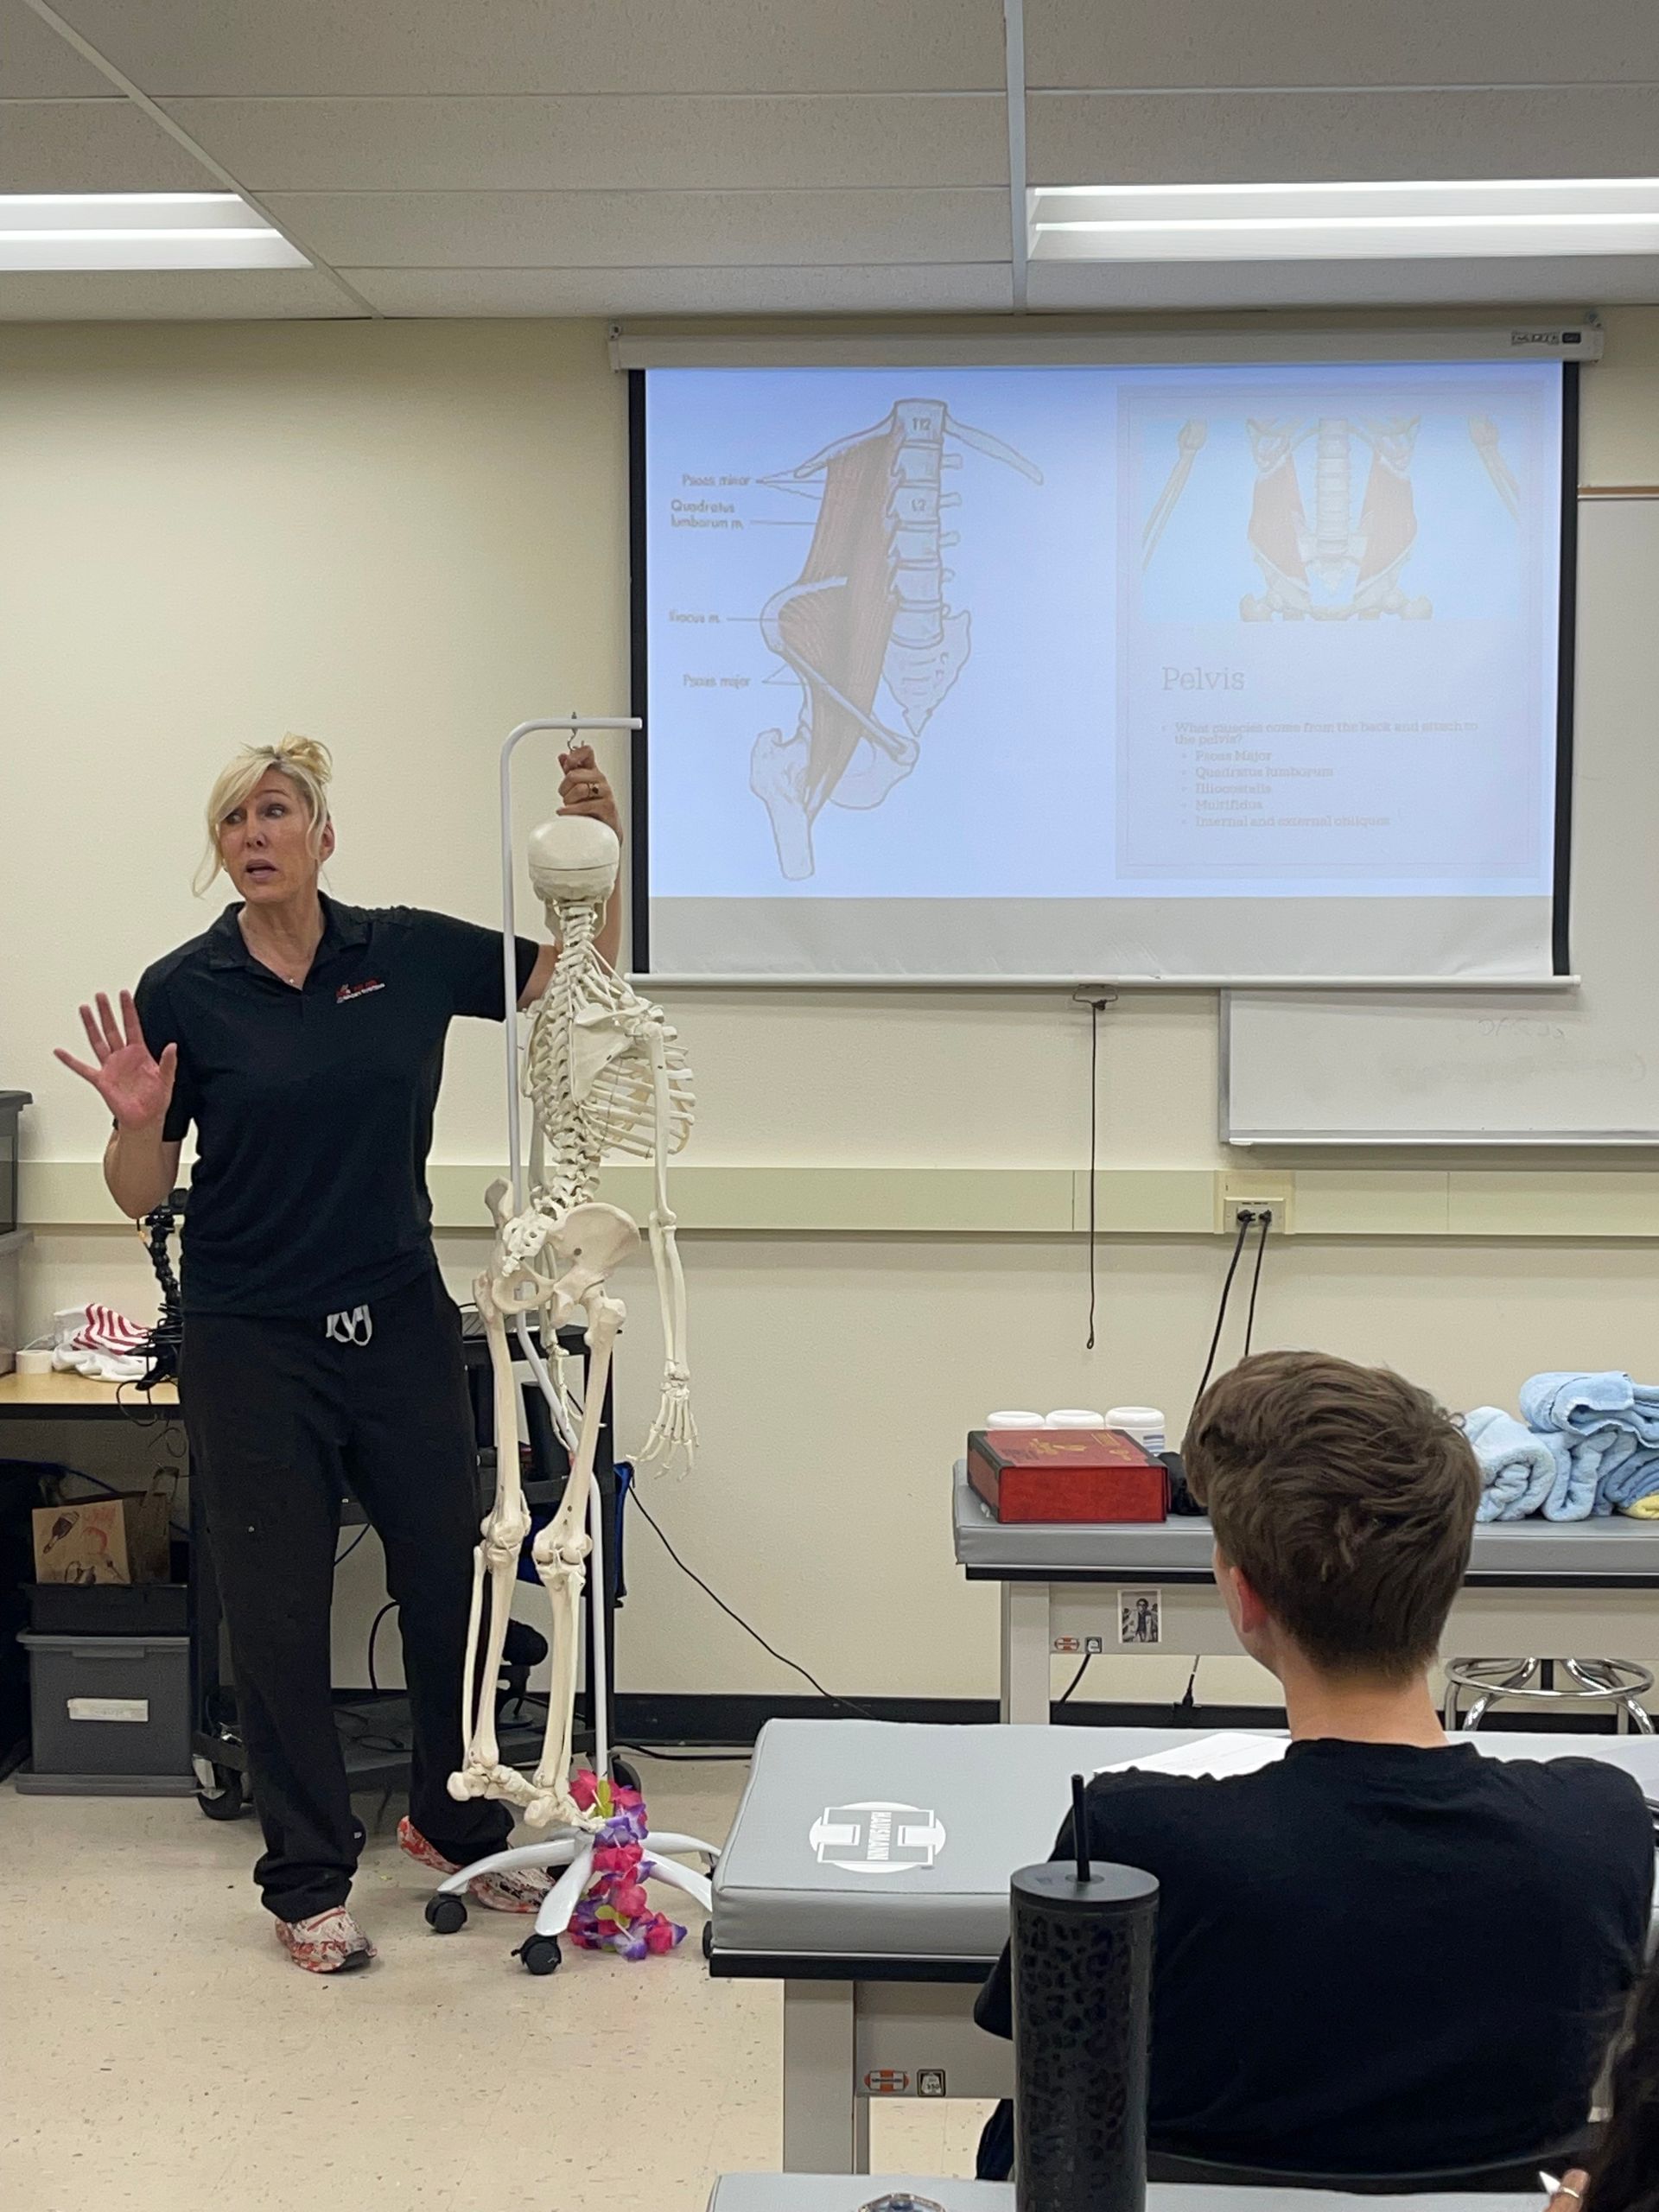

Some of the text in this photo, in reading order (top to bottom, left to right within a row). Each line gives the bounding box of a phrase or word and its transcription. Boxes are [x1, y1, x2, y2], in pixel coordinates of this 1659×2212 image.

[719, 473, 751, 486] minor
[671, 499, 735, 514] Quadratus
[1161, 666, 1245, 691] Pelvis
[1175, 722, 1210, 734] What
[1212, 723, 1263, 734] muscles
[1304, 722, 1335, 734] from
[1338, 722, 1358, 733] the
[1361, 721, 1391, 733] back
[1394, 721, 1420, 733] and
[1175, 734, 1243, 747] the pelvis?
[1235, 750, 1273, 763] Major
[1196, 766, 1264, 779] Quadratus
[1196, 800, 1263, 810] Multifidus
[1196, 816, 1390, 829] Internal and external obliques
